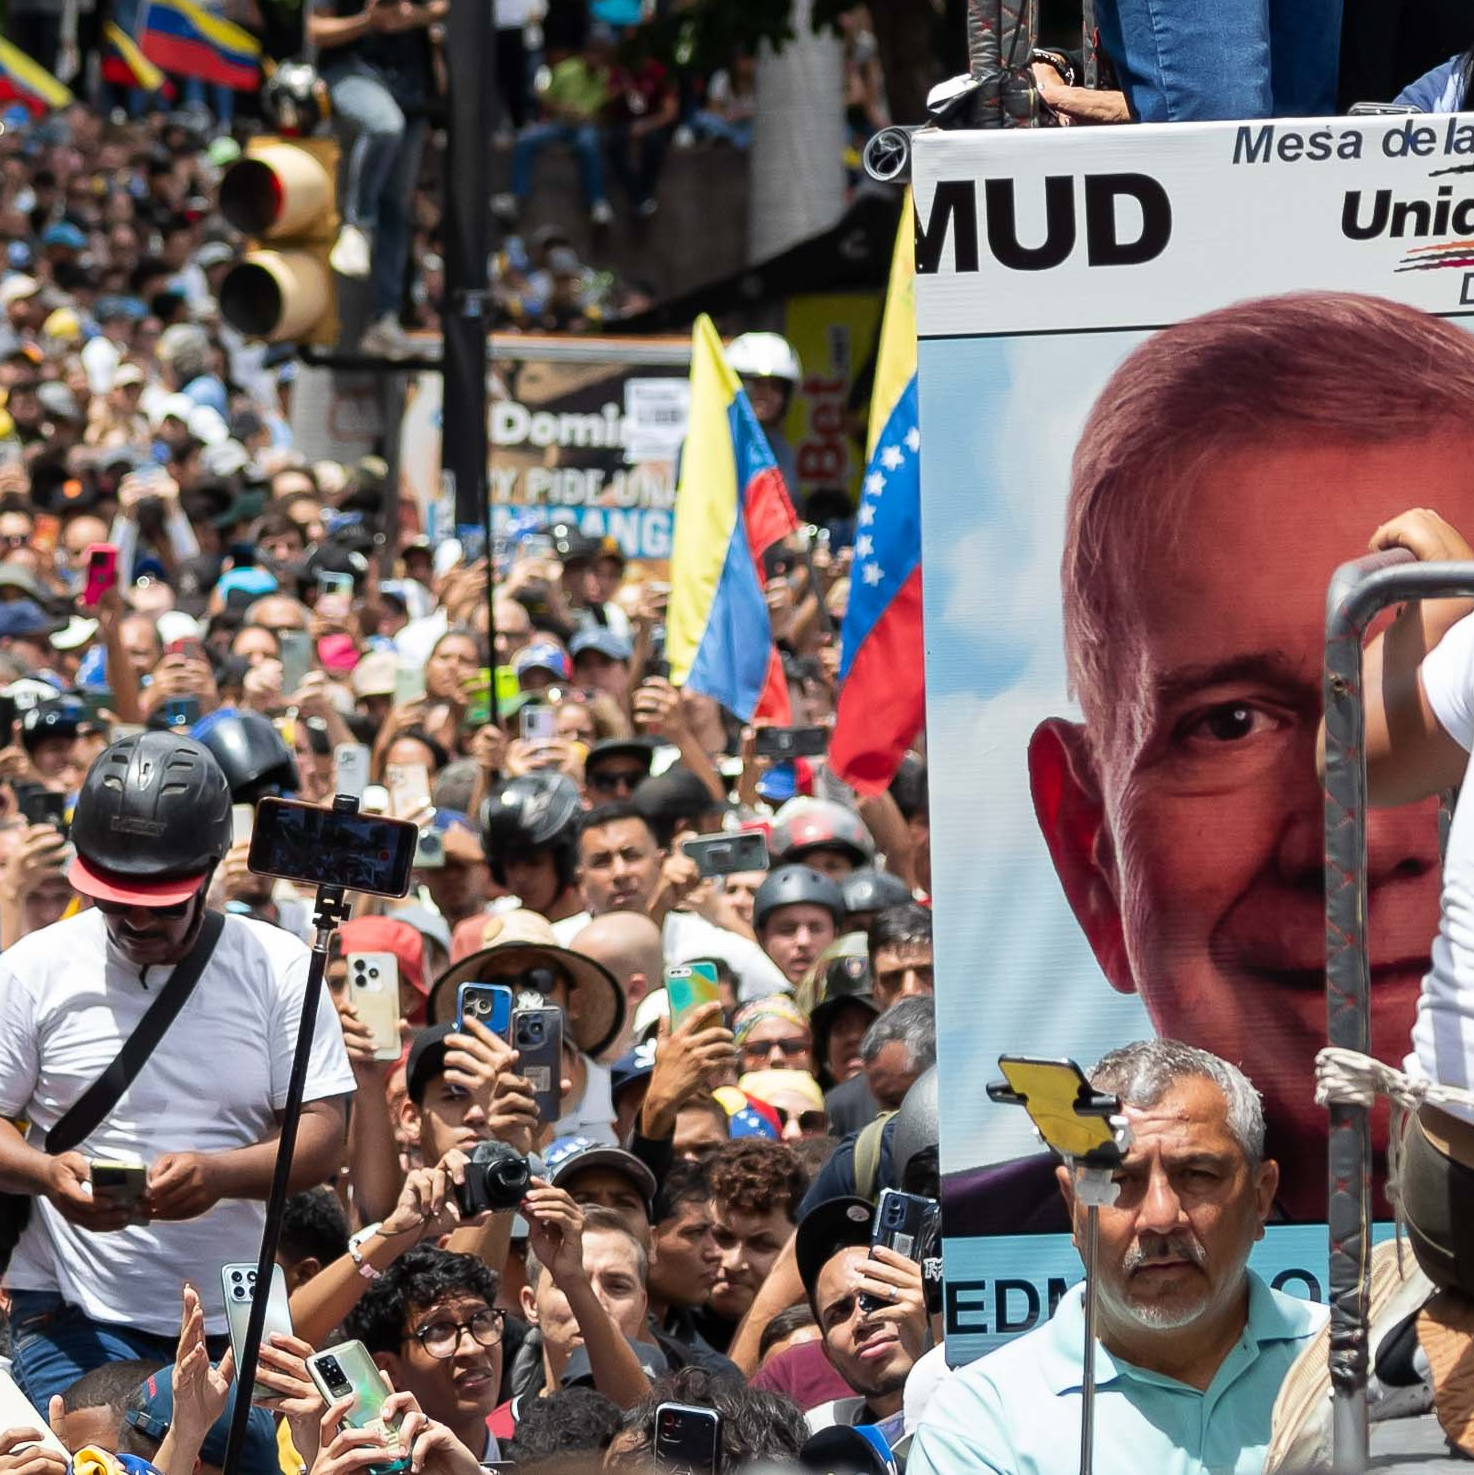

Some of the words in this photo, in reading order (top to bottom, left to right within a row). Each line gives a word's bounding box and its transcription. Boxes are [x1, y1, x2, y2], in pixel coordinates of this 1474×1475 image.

[1232, 124, 1363, 165] Mesa
[914, 172, 1173, 274] MUD
[489, 399, 628, 448] Domi
